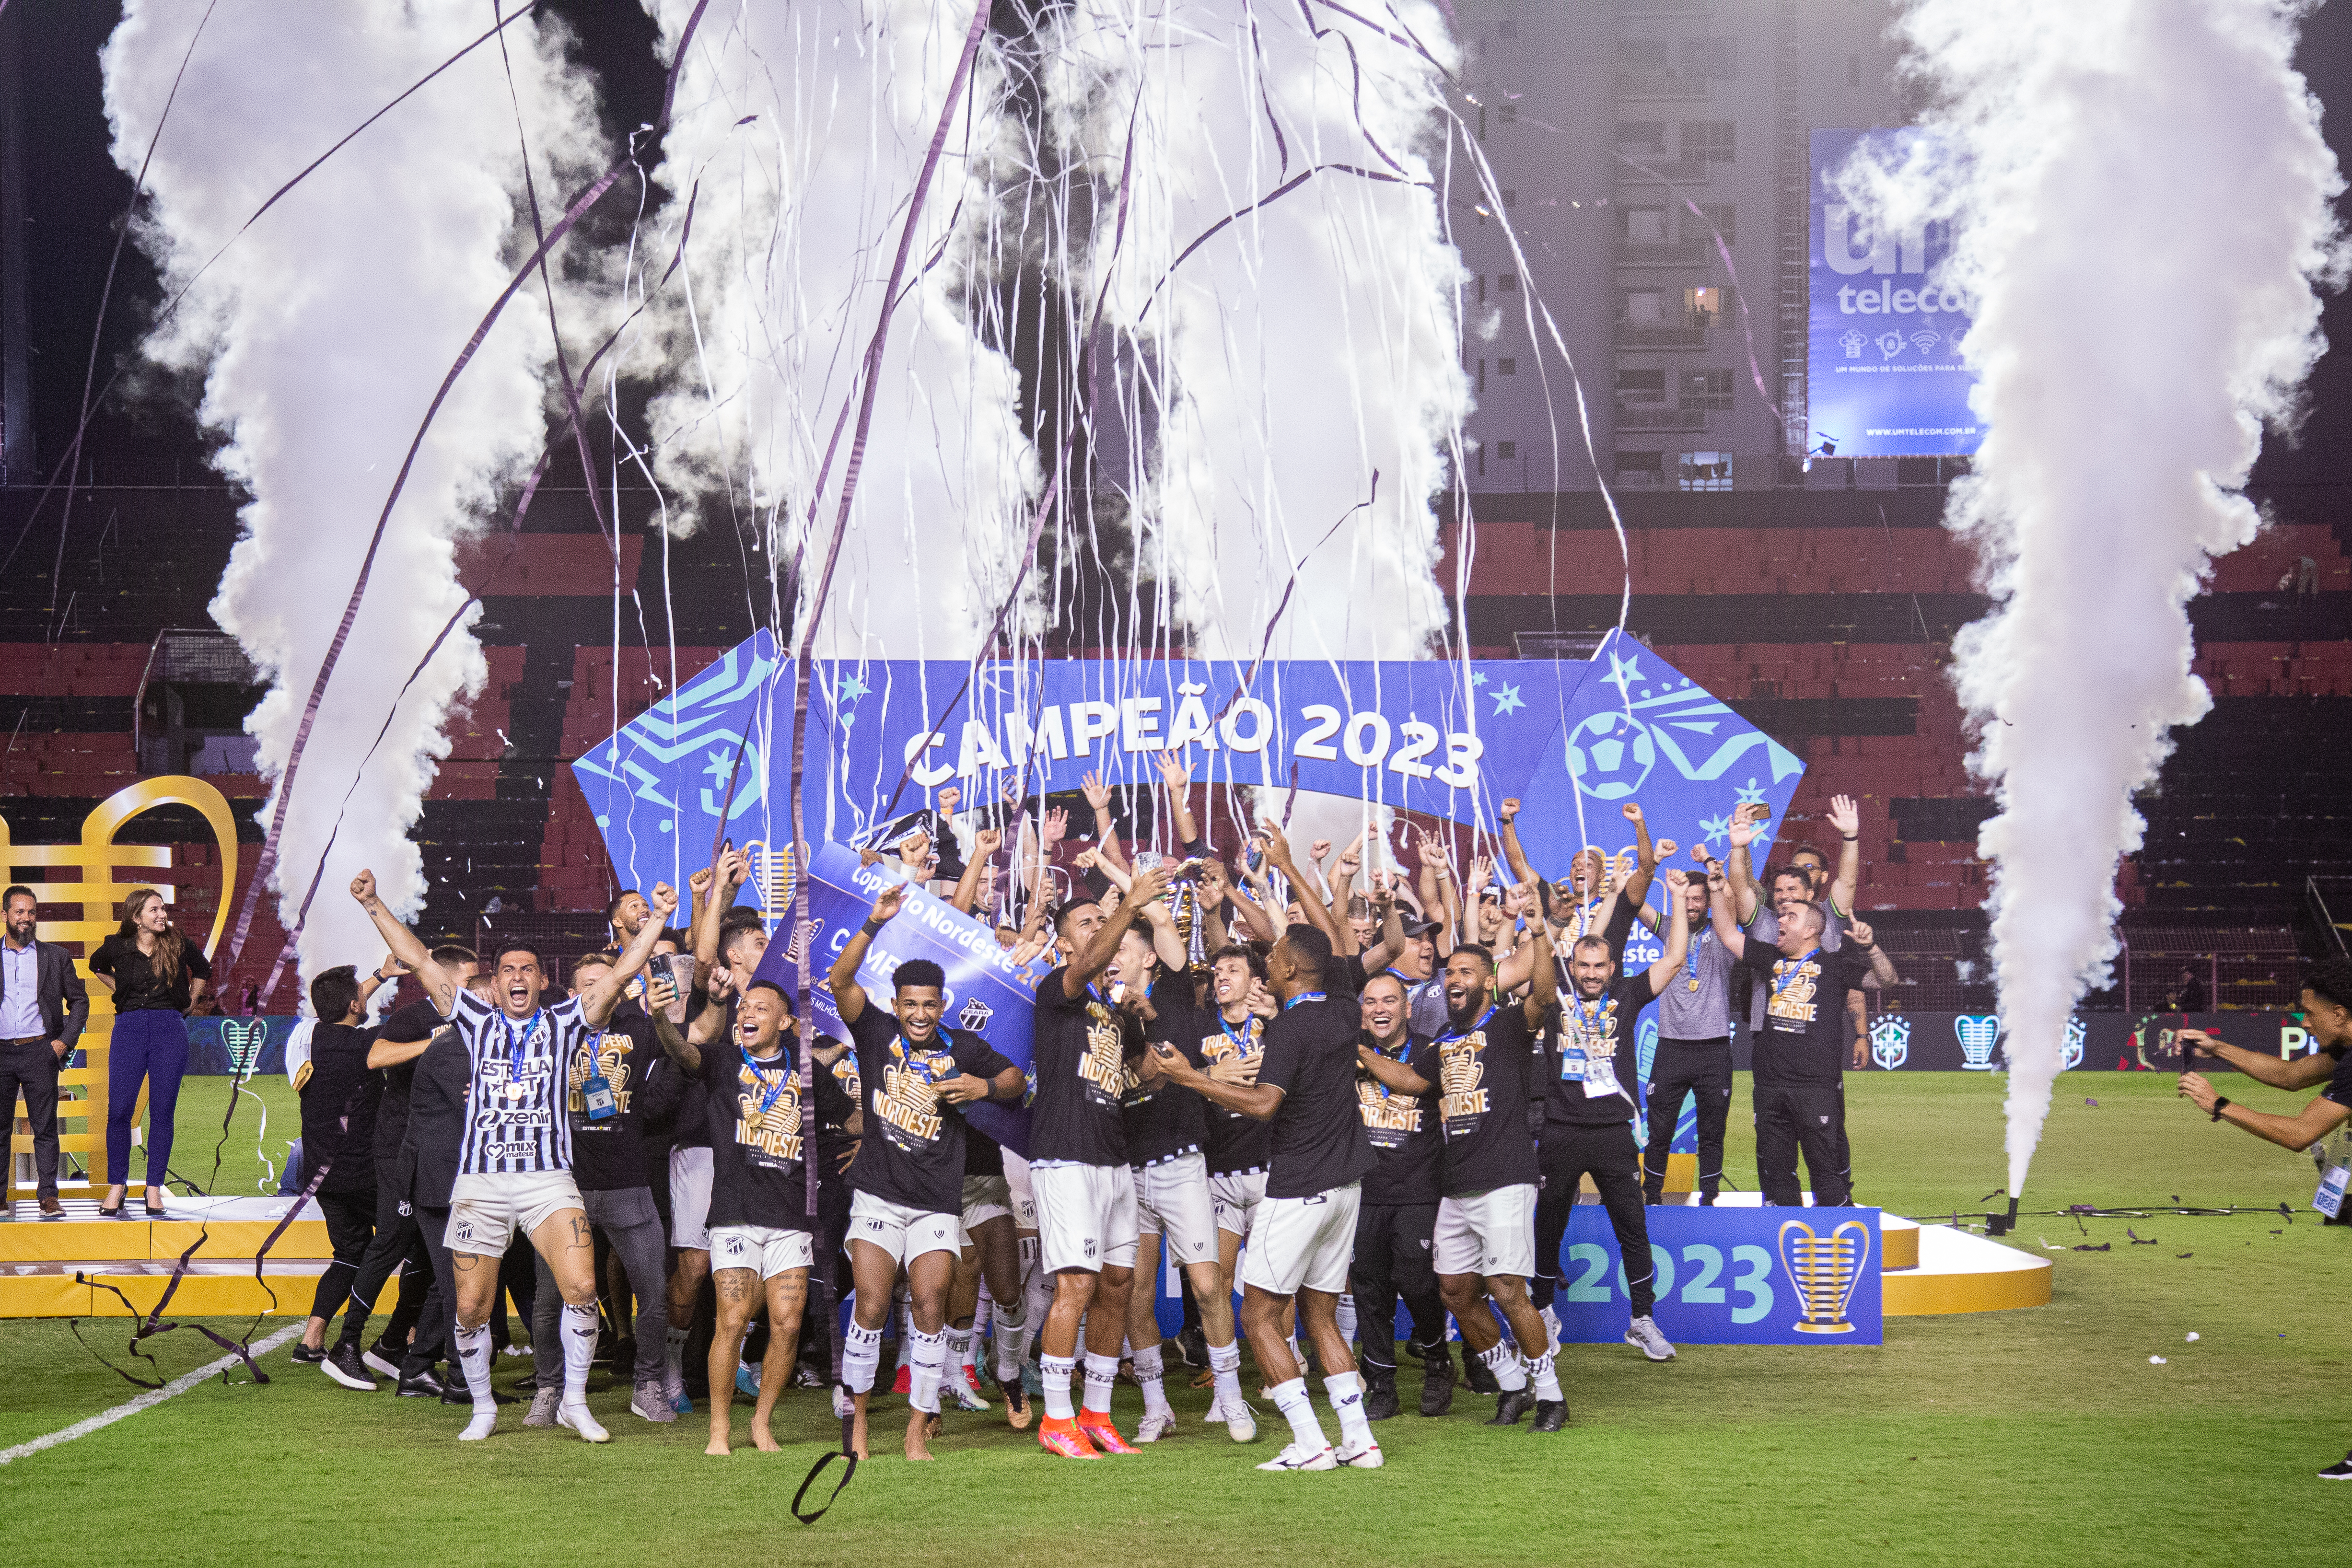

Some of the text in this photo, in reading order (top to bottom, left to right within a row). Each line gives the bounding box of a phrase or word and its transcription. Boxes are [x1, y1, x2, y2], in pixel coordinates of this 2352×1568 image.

[1837, 279, 1970, 314] teleco
[905, 681, 1484, 788] CAMPEÃO 2023
[852, 865, 894, 895] Copa
[921, 904, 1015, 974] Nordeste
[504, 1109, 550, 1124] zenir
[873, 1089, 943, 1141] NORDESTE
[506, 1142, 535, 1152] mix
[1568, 1243, 1774, 1324] 2023
